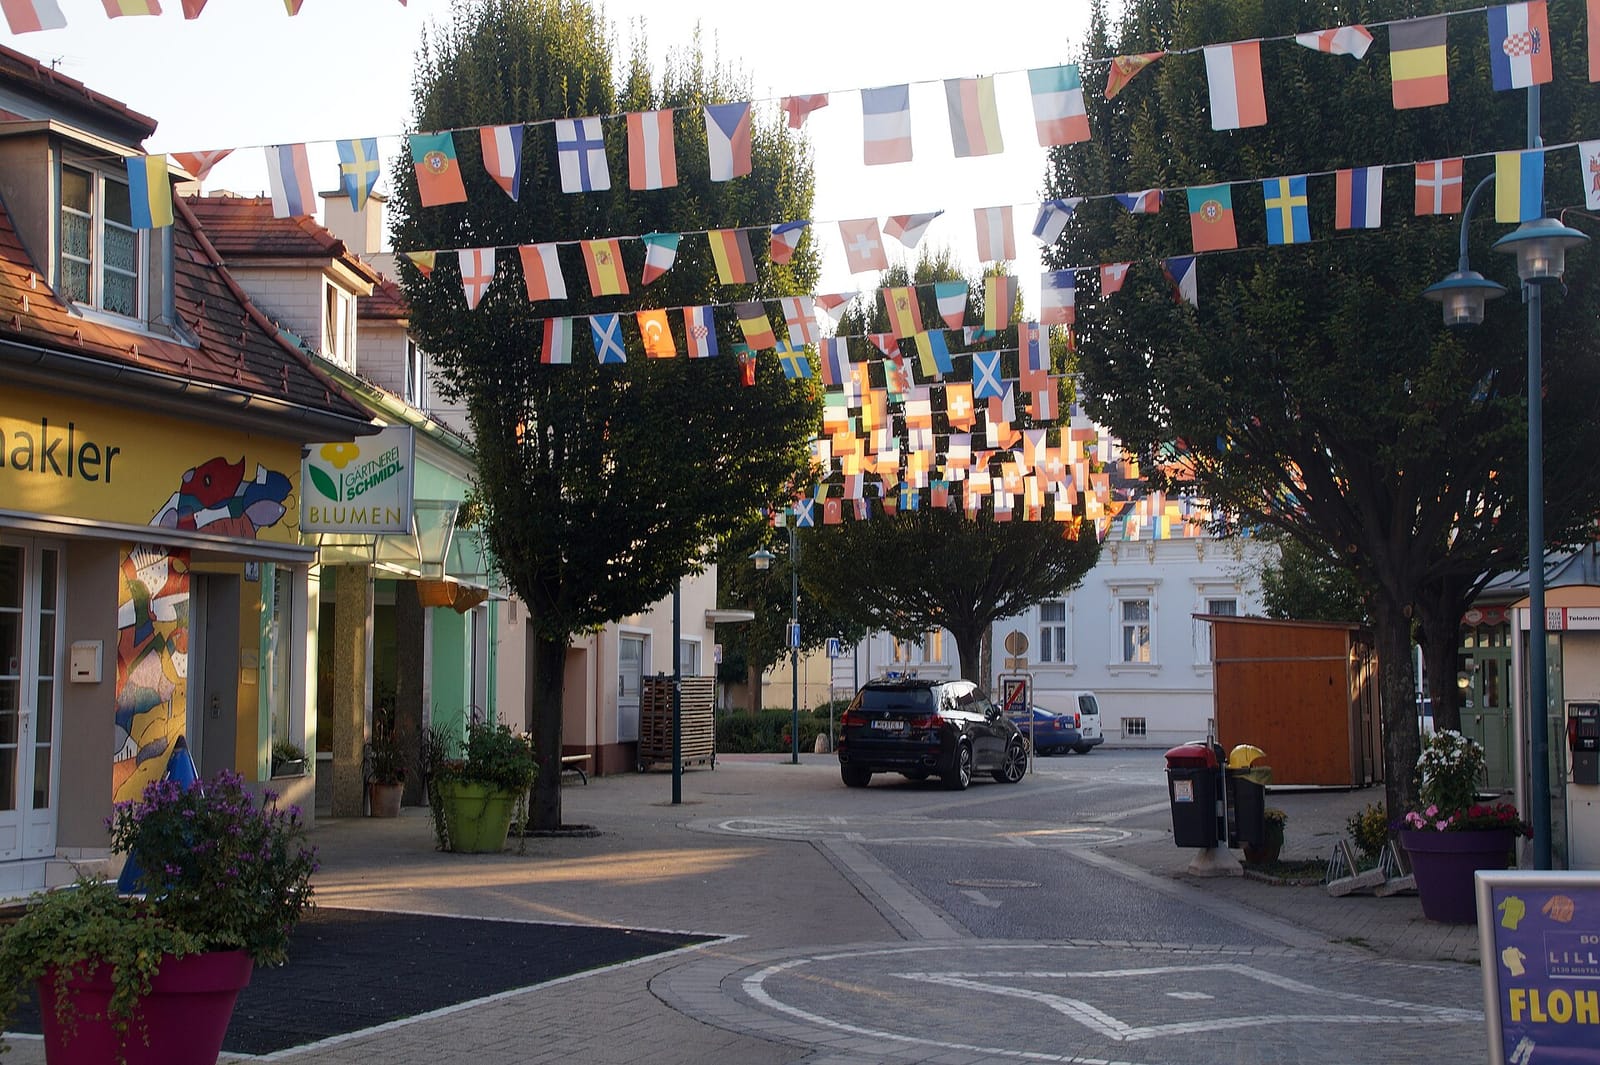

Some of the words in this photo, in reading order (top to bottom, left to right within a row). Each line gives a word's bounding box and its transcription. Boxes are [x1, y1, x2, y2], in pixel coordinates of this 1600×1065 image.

[345, 446, 400, 487] GÄRTNEREI
[346, 461, 404, 501] SCHMIDL
[309, 506, 401, 525] BLUMEN
[1550, 951, 1598, 964] LILL
[1509, 988, 1600, 1024] FLOH
